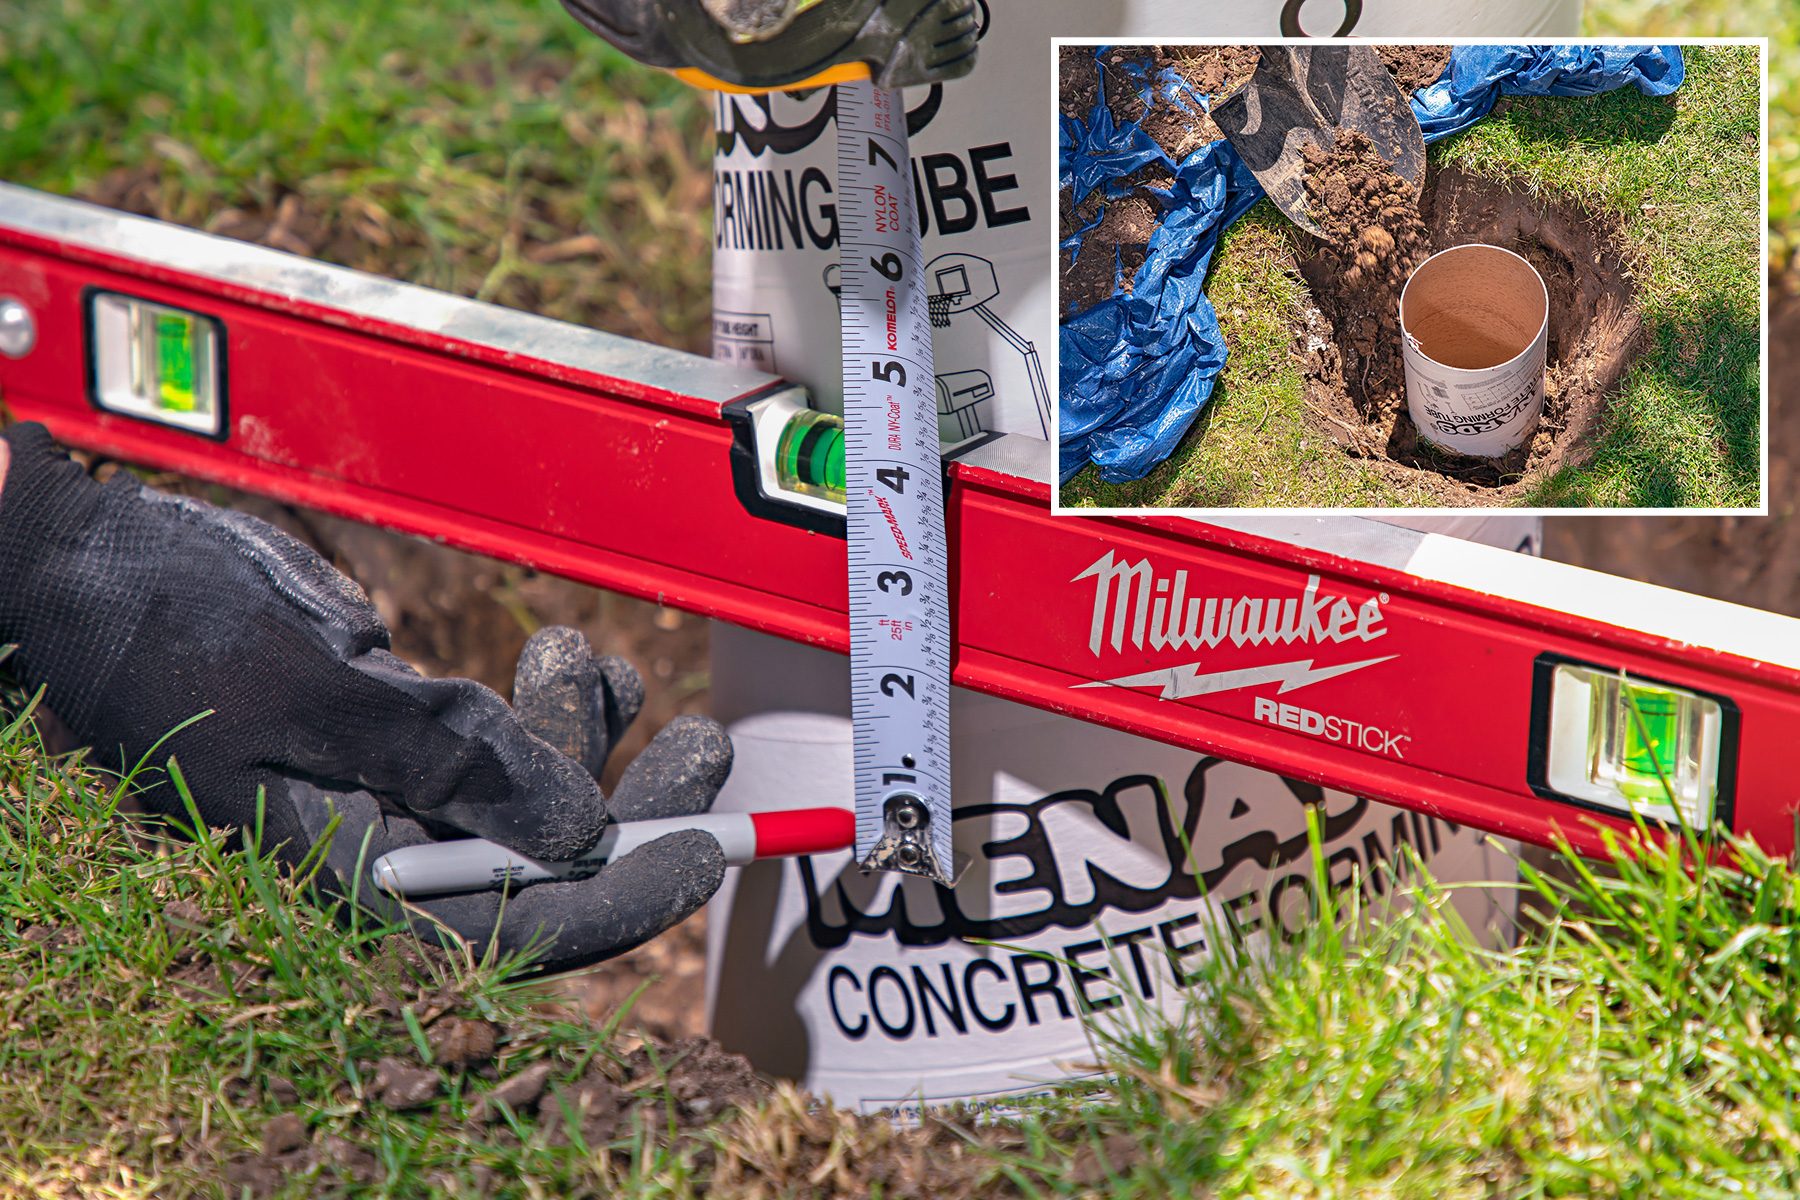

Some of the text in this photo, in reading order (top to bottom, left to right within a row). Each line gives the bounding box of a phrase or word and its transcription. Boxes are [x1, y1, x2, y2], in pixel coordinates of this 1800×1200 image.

[868, 137, 898, 173] 7
[910, 141, 1031, 238] BE
[874, 185, 887, 233] NYLON
[888, 192, 899, 232] COAT
[870, 252, 903, 282] 6
[886, 290, 897, 351] KOMELON
[872, 360, 907, 388] 5
[1424, 405, 1453, 422] TUBE
[1453, 403, 1511, 424] FORMING
[888, 434, 902, 451] DURA
[876, 466, 910, 494] 4
[877, 571, 913, 597] 3
[1070, 549, 1388, 658] Milwaukee
[891, 620, 903, 641] 25ft
[904, 621, 913, 631] in
[880, 673, 915, 700] 2
[1253, 696, 1405, 758] REDSTICK
[882, 773, 917, 786] 1
[827, 810, 1460, 1041] CONCRETE FORMI
